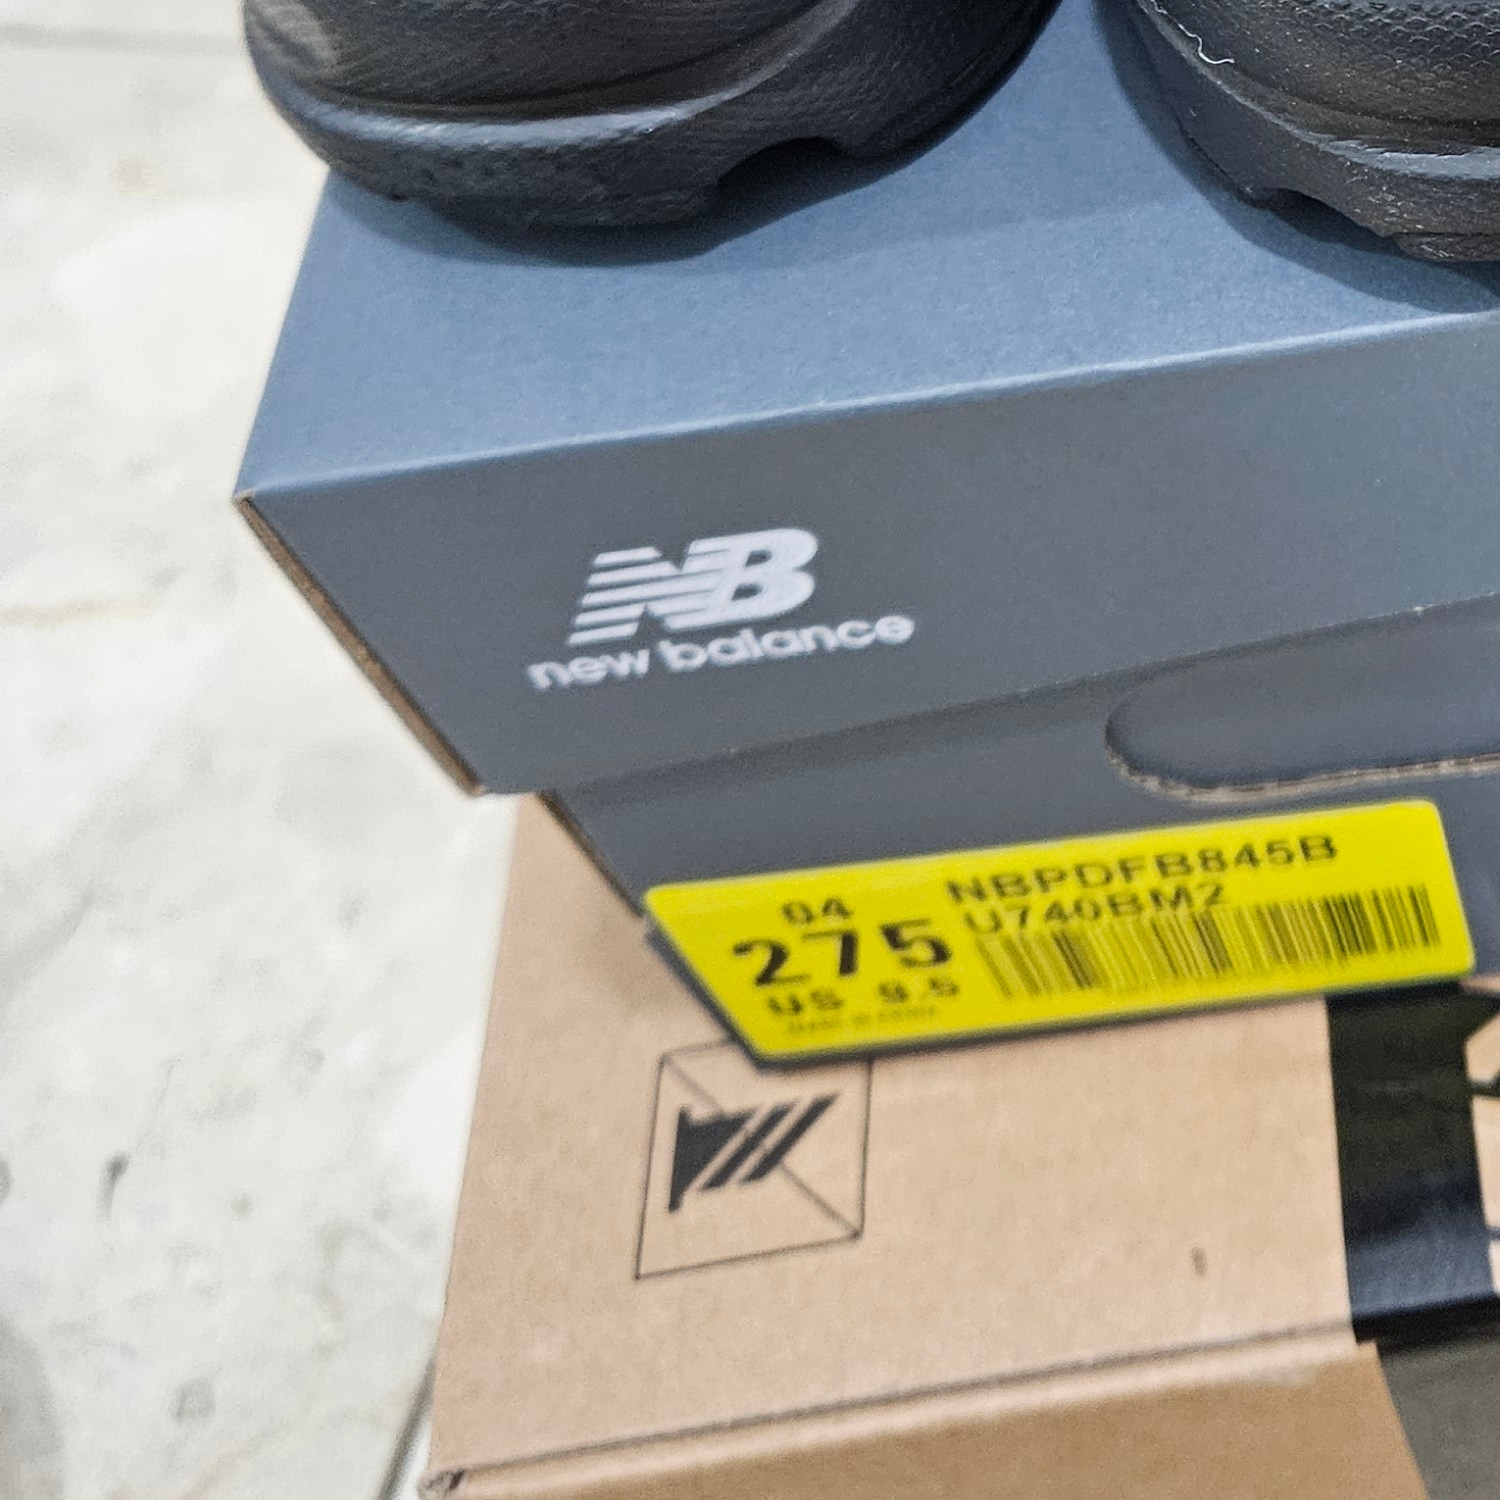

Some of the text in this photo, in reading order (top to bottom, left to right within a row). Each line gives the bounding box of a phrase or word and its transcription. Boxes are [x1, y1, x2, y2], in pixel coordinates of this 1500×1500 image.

[526, 613, 916, 692] new balance
[964, 881, 1224, 935] U740BM2
[731, 917, 953, 988] 275
